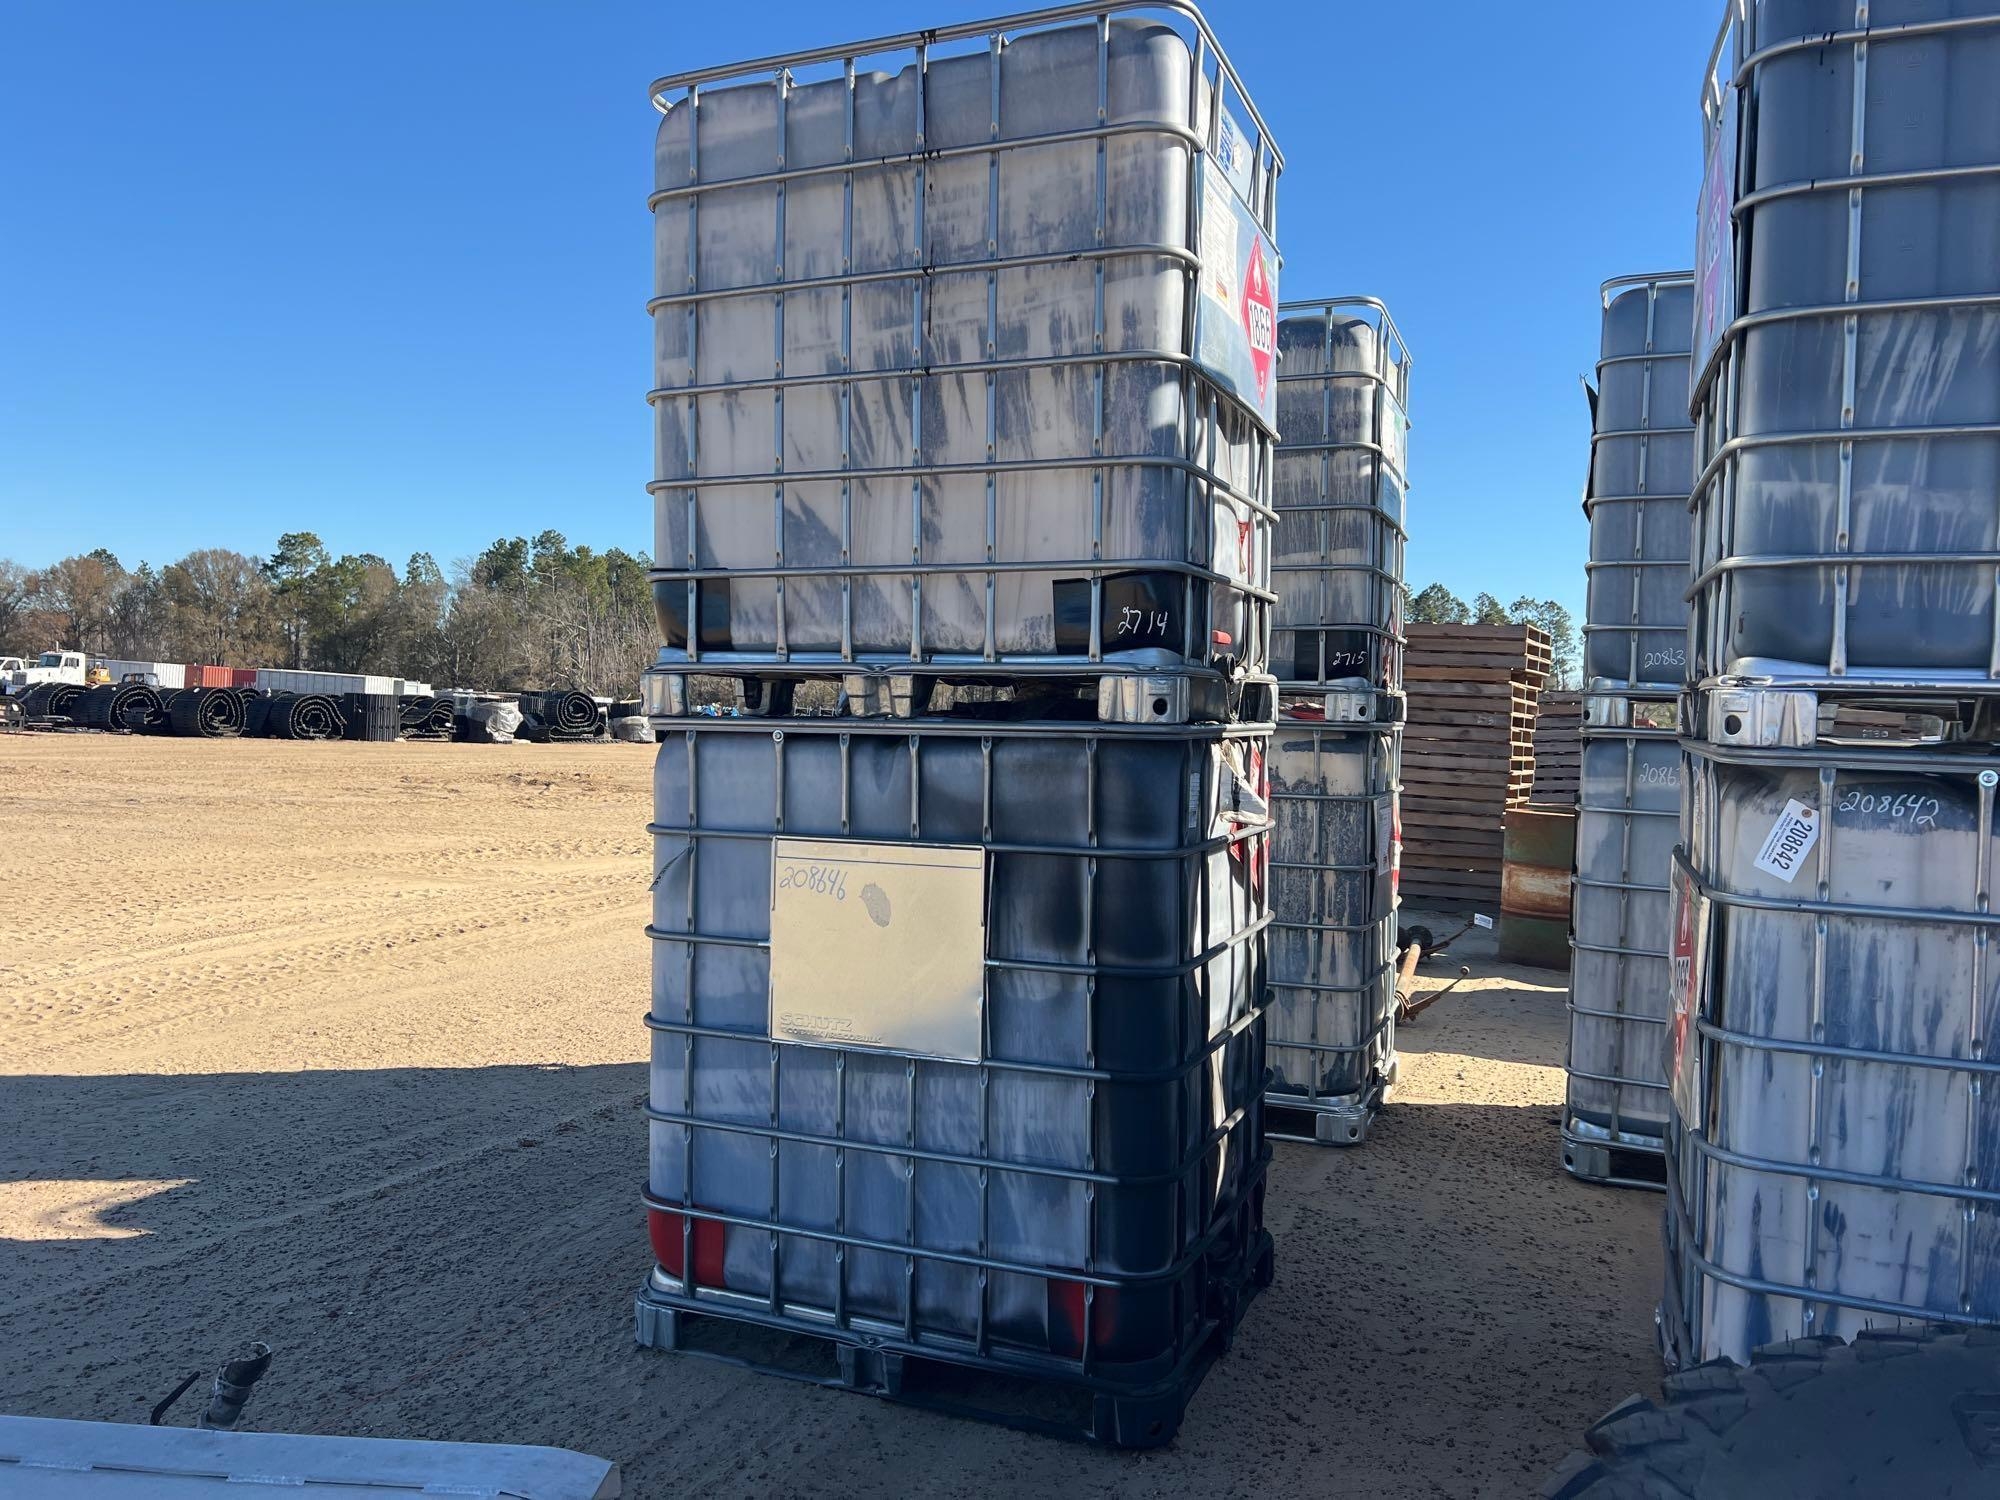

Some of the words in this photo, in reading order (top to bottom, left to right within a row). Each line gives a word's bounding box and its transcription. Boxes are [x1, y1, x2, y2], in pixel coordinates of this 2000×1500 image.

[1250, 303, 1271, 351] 1866
[1117, 606, 1169, 636] 2714
[1332, 651, 1368, 666] 2715
[1839, 791, 1940, 827] 208642
[1771, 818, 1813, 870] 208642
[779, 865, 848, 901] 208646
